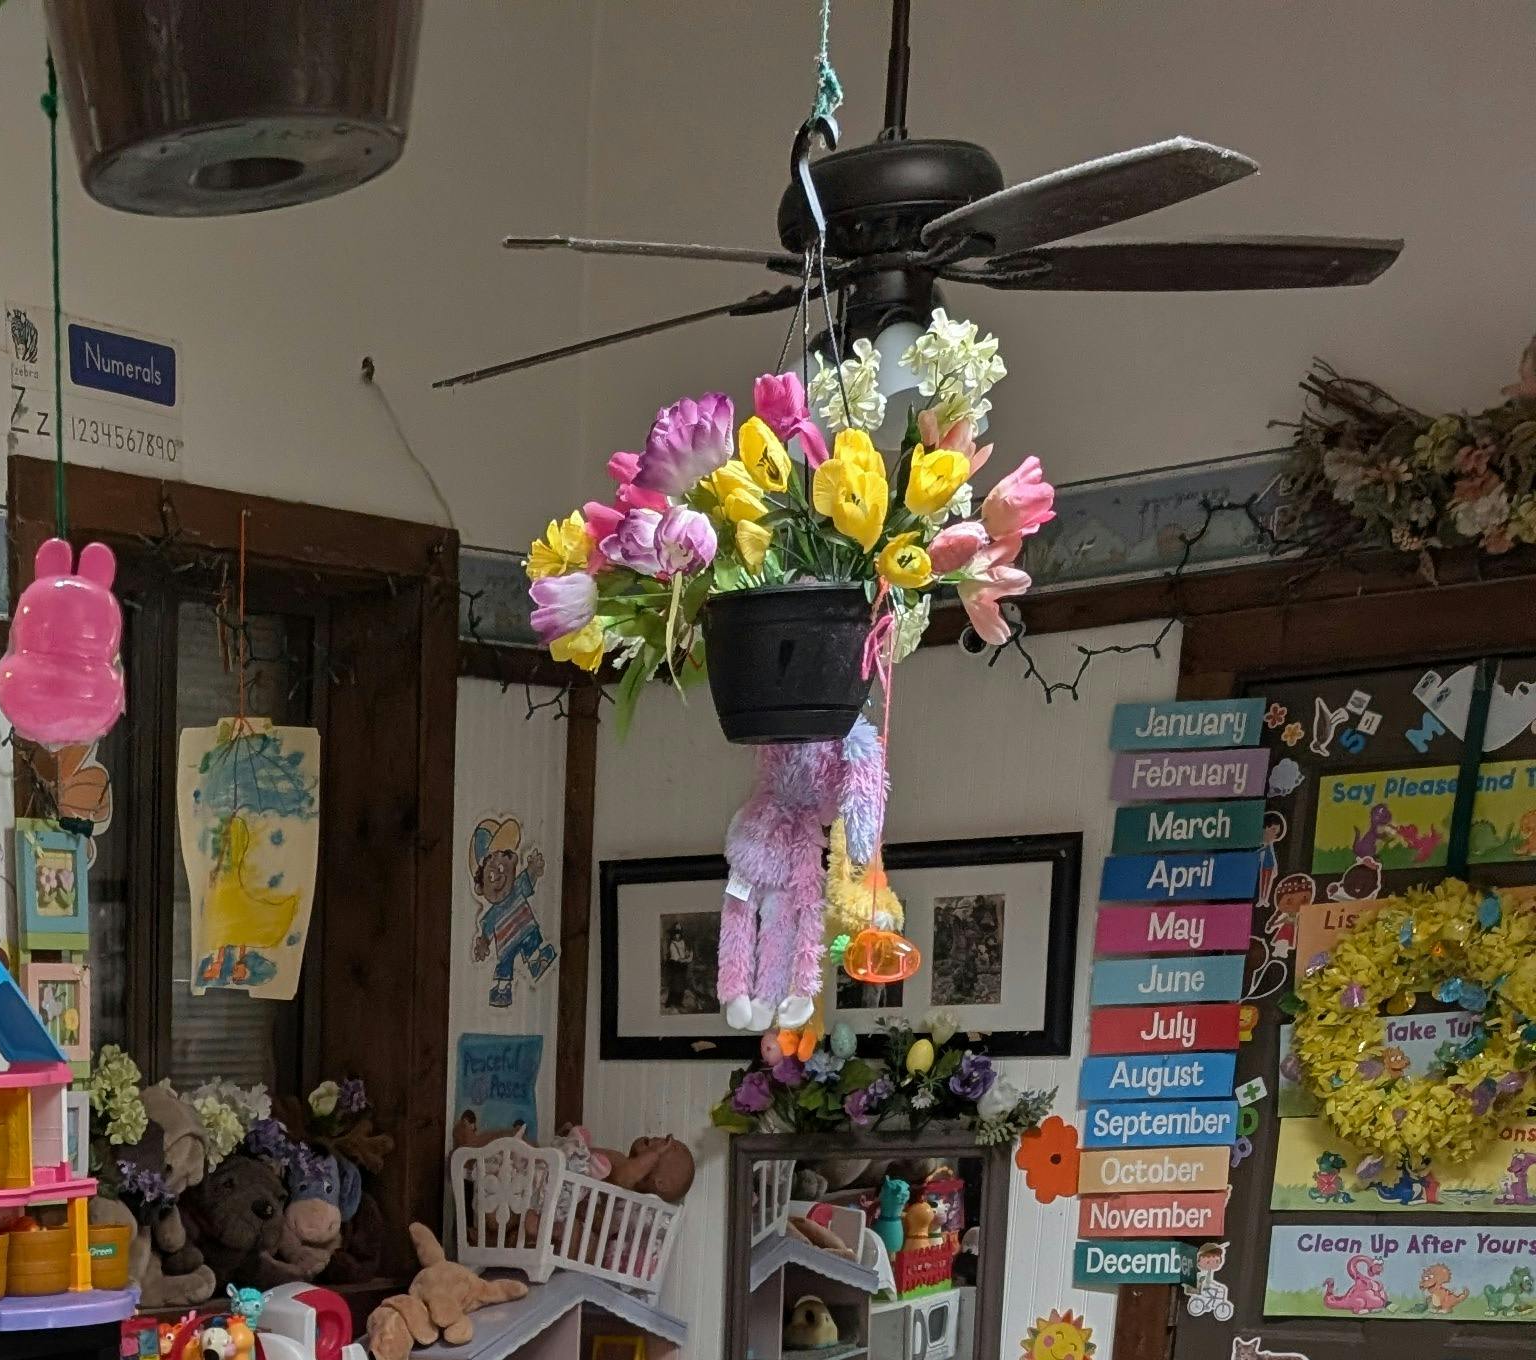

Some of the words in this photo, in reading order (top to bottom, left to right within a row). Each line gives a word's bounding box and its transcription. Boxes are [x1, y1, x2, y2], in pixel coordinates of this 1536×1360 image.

[84, 341, 163, 387] Numerals
[70, 416, 177, 463] 1234567890
[1135, 706, 1248, 745] January
[1131, 757, 1250, 795] February
[1332, 779, 1376, 806] Say
[1384, 776, 1458, 800] Please
[1146, 808, 1232, 843] March
[1146, 857, 1215, 897] April
[1147, 911, 1206, 949] May
[1138, 964, 1206, 994] June
[1140, 1011, 1197, 1048] July
[1385, 1019, 1437, 1044] Take
[1108, 1060, 1205, 1097] August
[1092, 1107, 1232, 1145] September
[1100, 1156, 1205, 1186] October
[1089, 1201, 1213, 1230] November
[1085, 1246, 1194, 1278] December
[1297, 1232, 1363, 1255] Clean
[1369, 1233, 1400, 1258] Up
[1405, 1233, 1467, 1256] After
